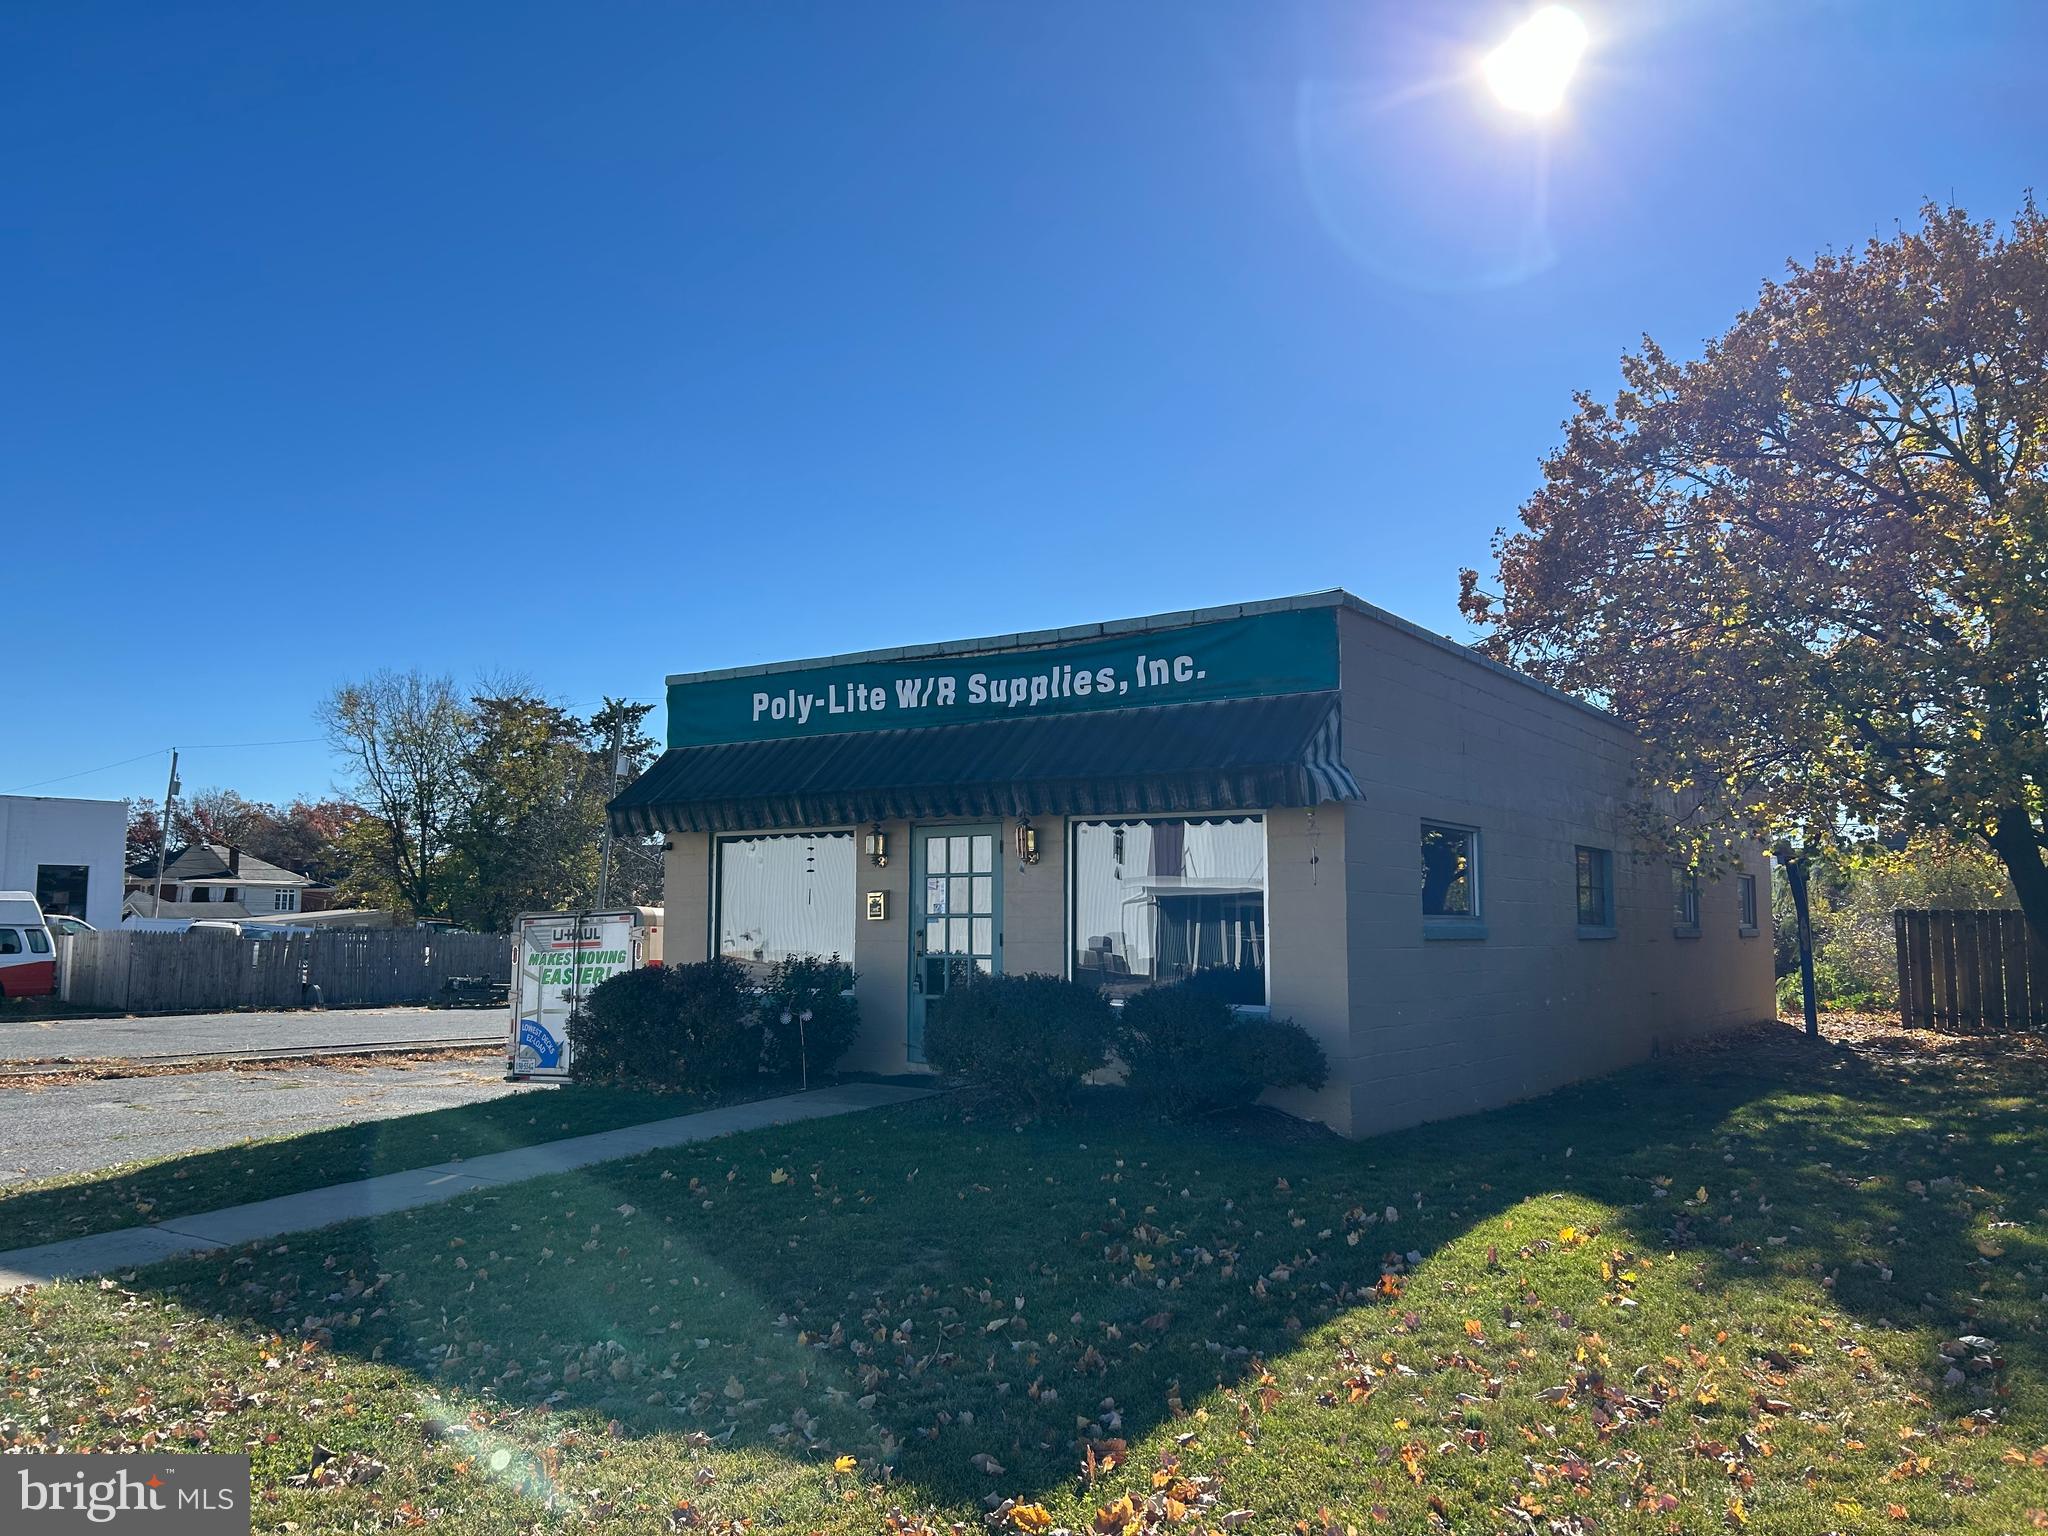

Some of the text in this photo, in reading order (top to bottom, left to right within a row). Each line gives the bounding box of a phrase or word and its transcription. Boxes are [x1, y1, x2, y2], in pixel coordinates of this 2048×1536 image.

[752, 654, 1207, 725] Poly-Lite W/R Supplies, Inc.
[528, 950, 627, 966] MAKES MOVING
[521, 1024, 555, 1055] LOWEST DECKS
